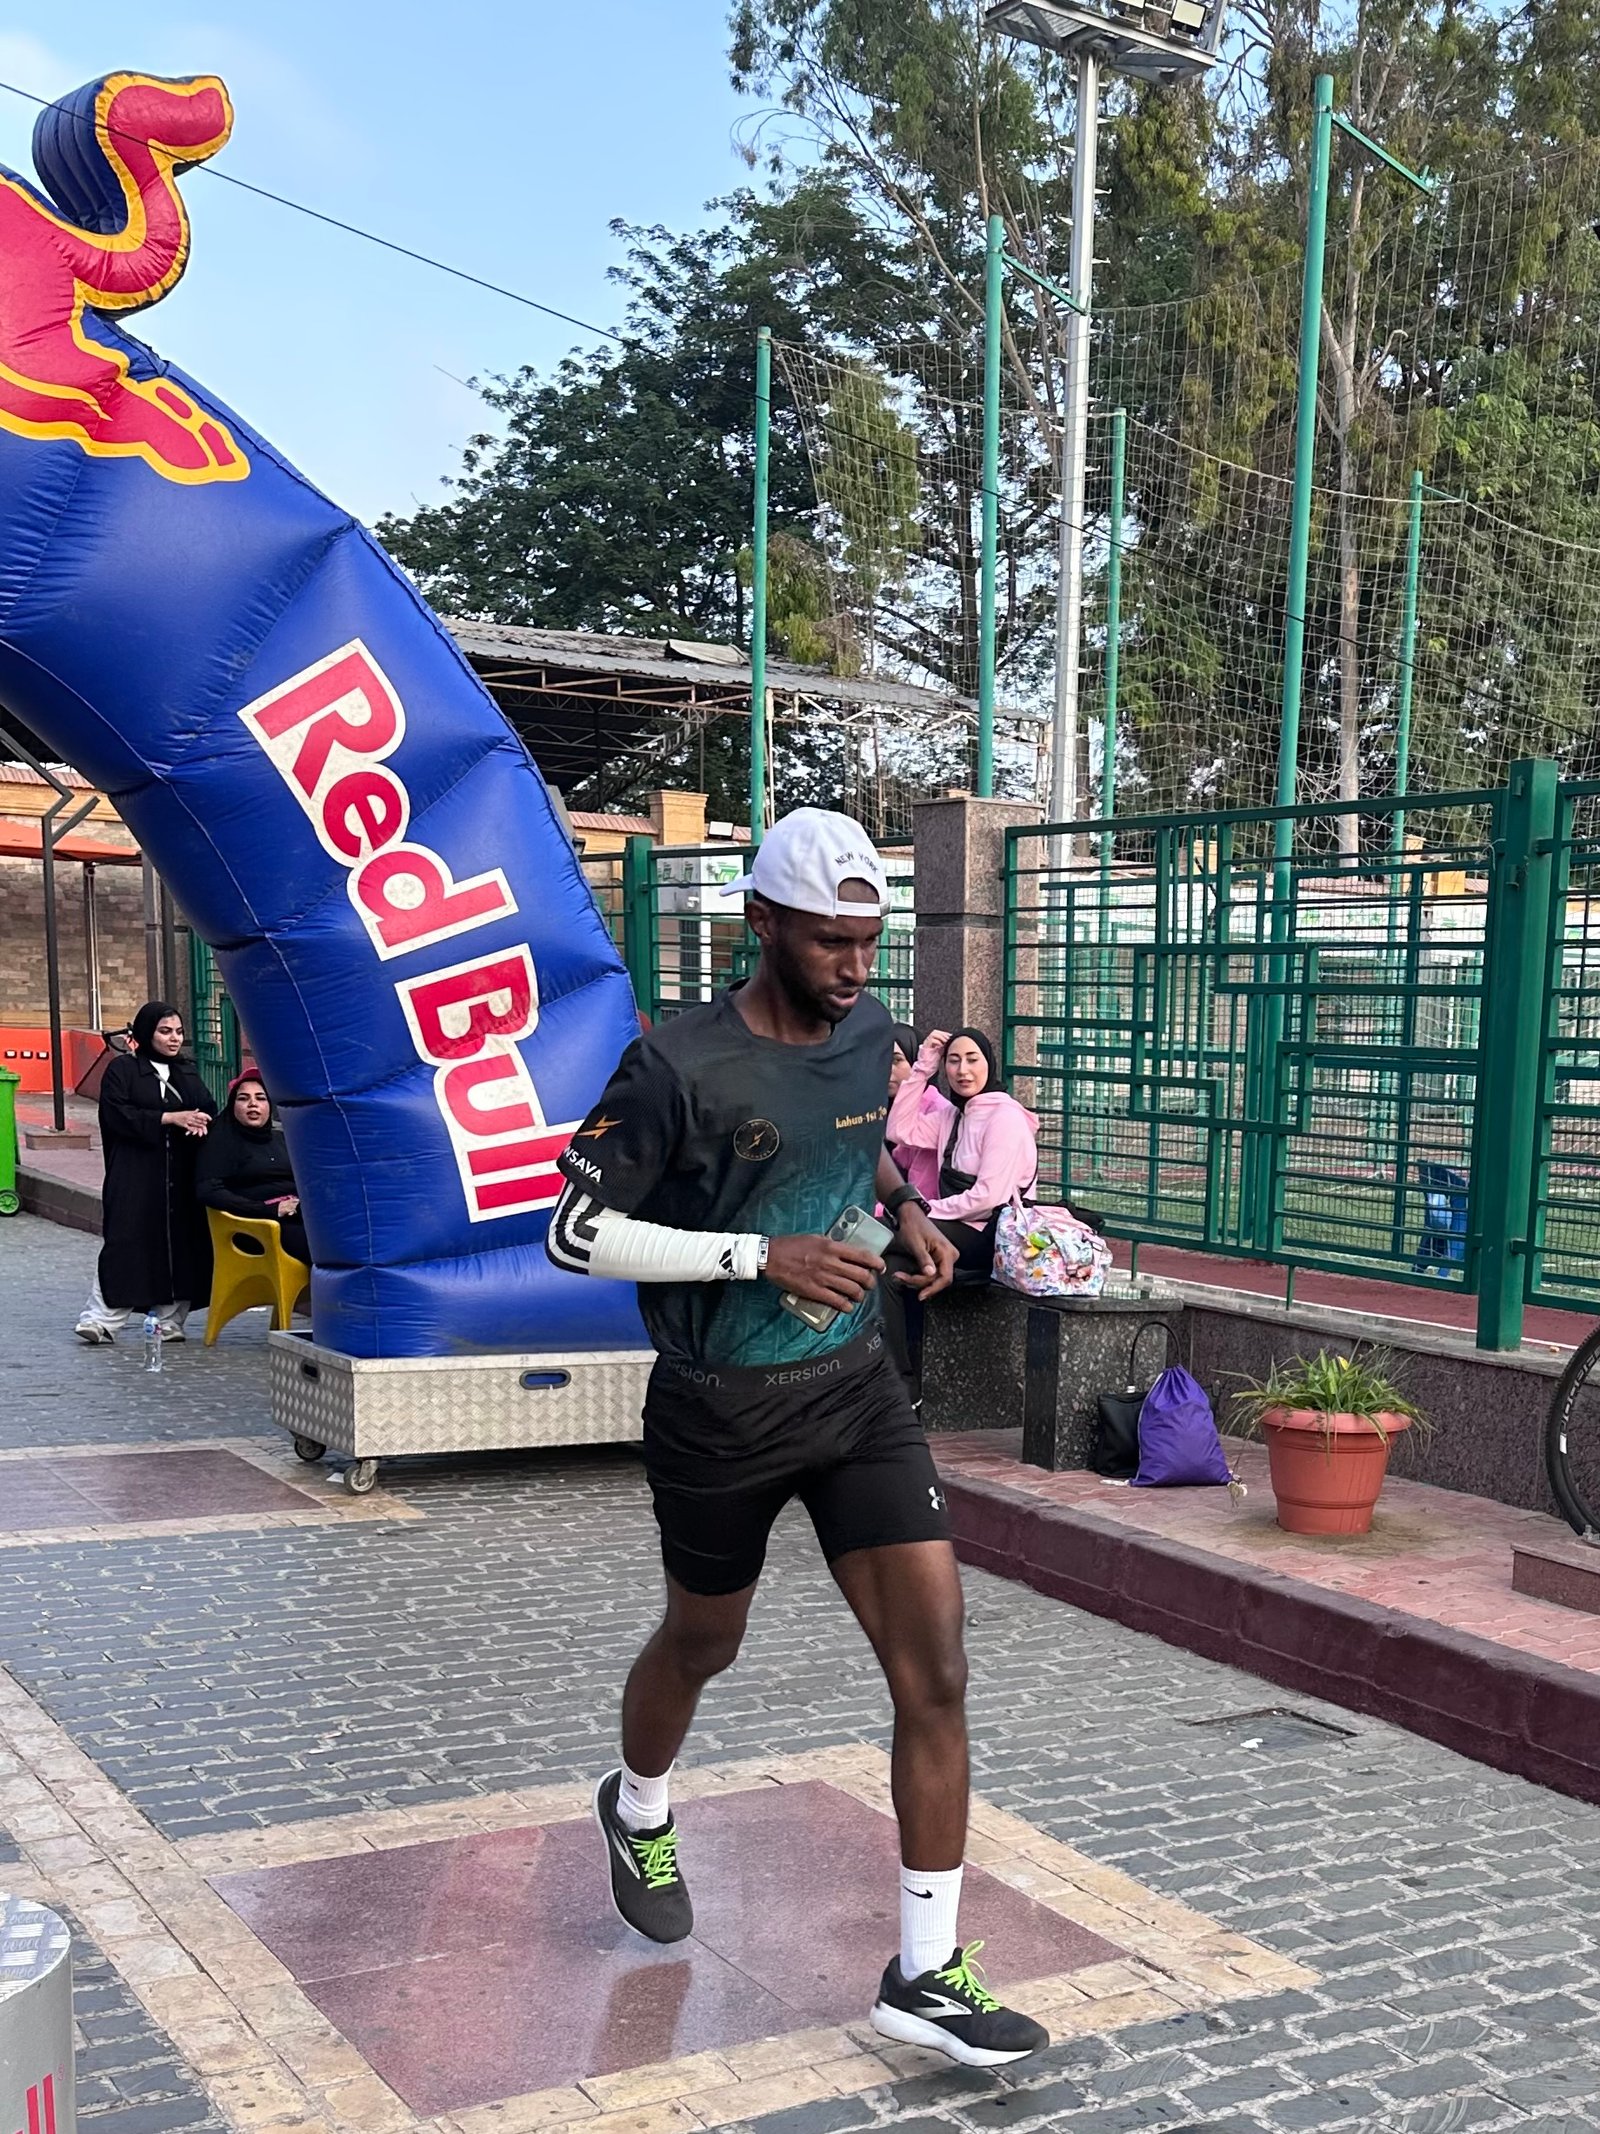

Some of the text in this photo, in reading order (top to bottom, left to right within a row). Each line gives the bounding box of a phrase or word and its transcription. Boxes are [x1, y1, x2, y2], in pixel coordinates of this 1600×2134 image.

[246, 644, 578, 1214] Red Bull
[835, 851, 879, 874] NEW YORK
